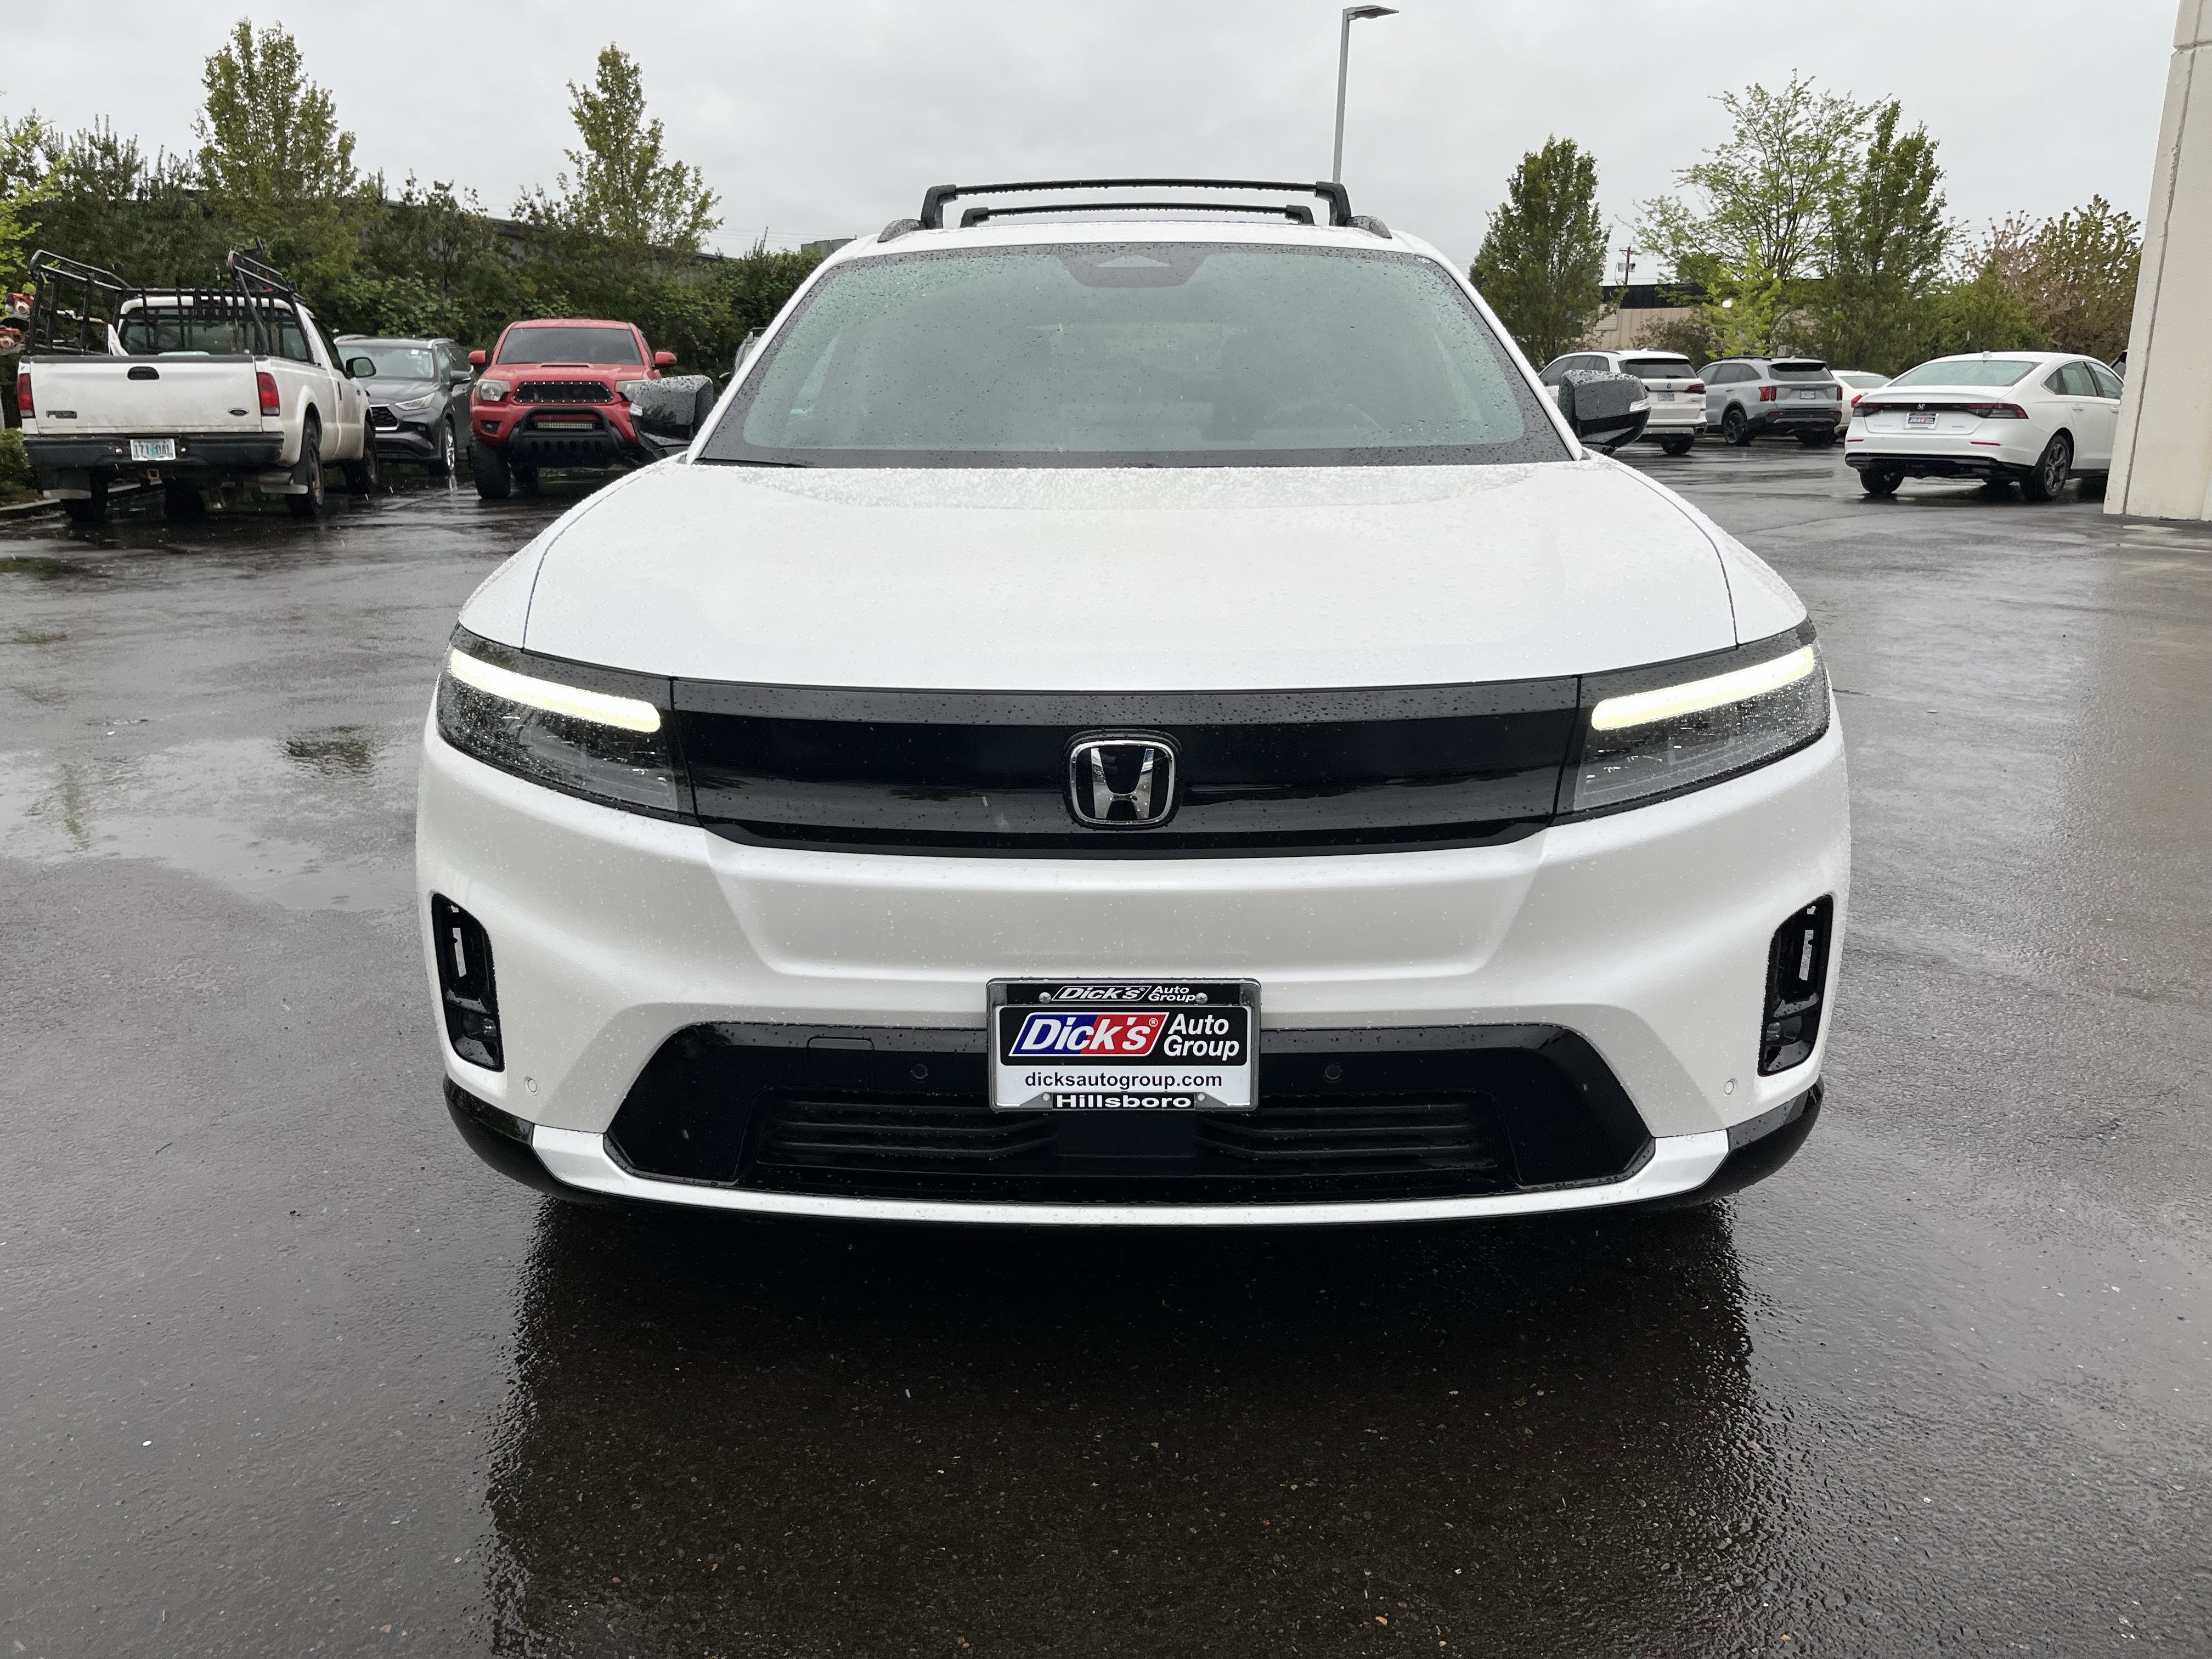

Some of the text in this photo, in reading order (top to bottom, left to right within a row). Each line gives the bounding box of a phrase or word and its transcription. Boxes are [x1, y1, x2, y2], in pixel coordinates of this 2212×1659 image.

[1148, 992, 1197, 1003] Group
[1152, 985, 1190, 994] Auto
[1167, 1013, 1229, 1035] Auto
[1163, 1035, 1240, 1061] Group
[1024, 1071, 1222, 1090] dicksautogroup.com
[1056, 1095, 1192, 1108] Hillsboro
